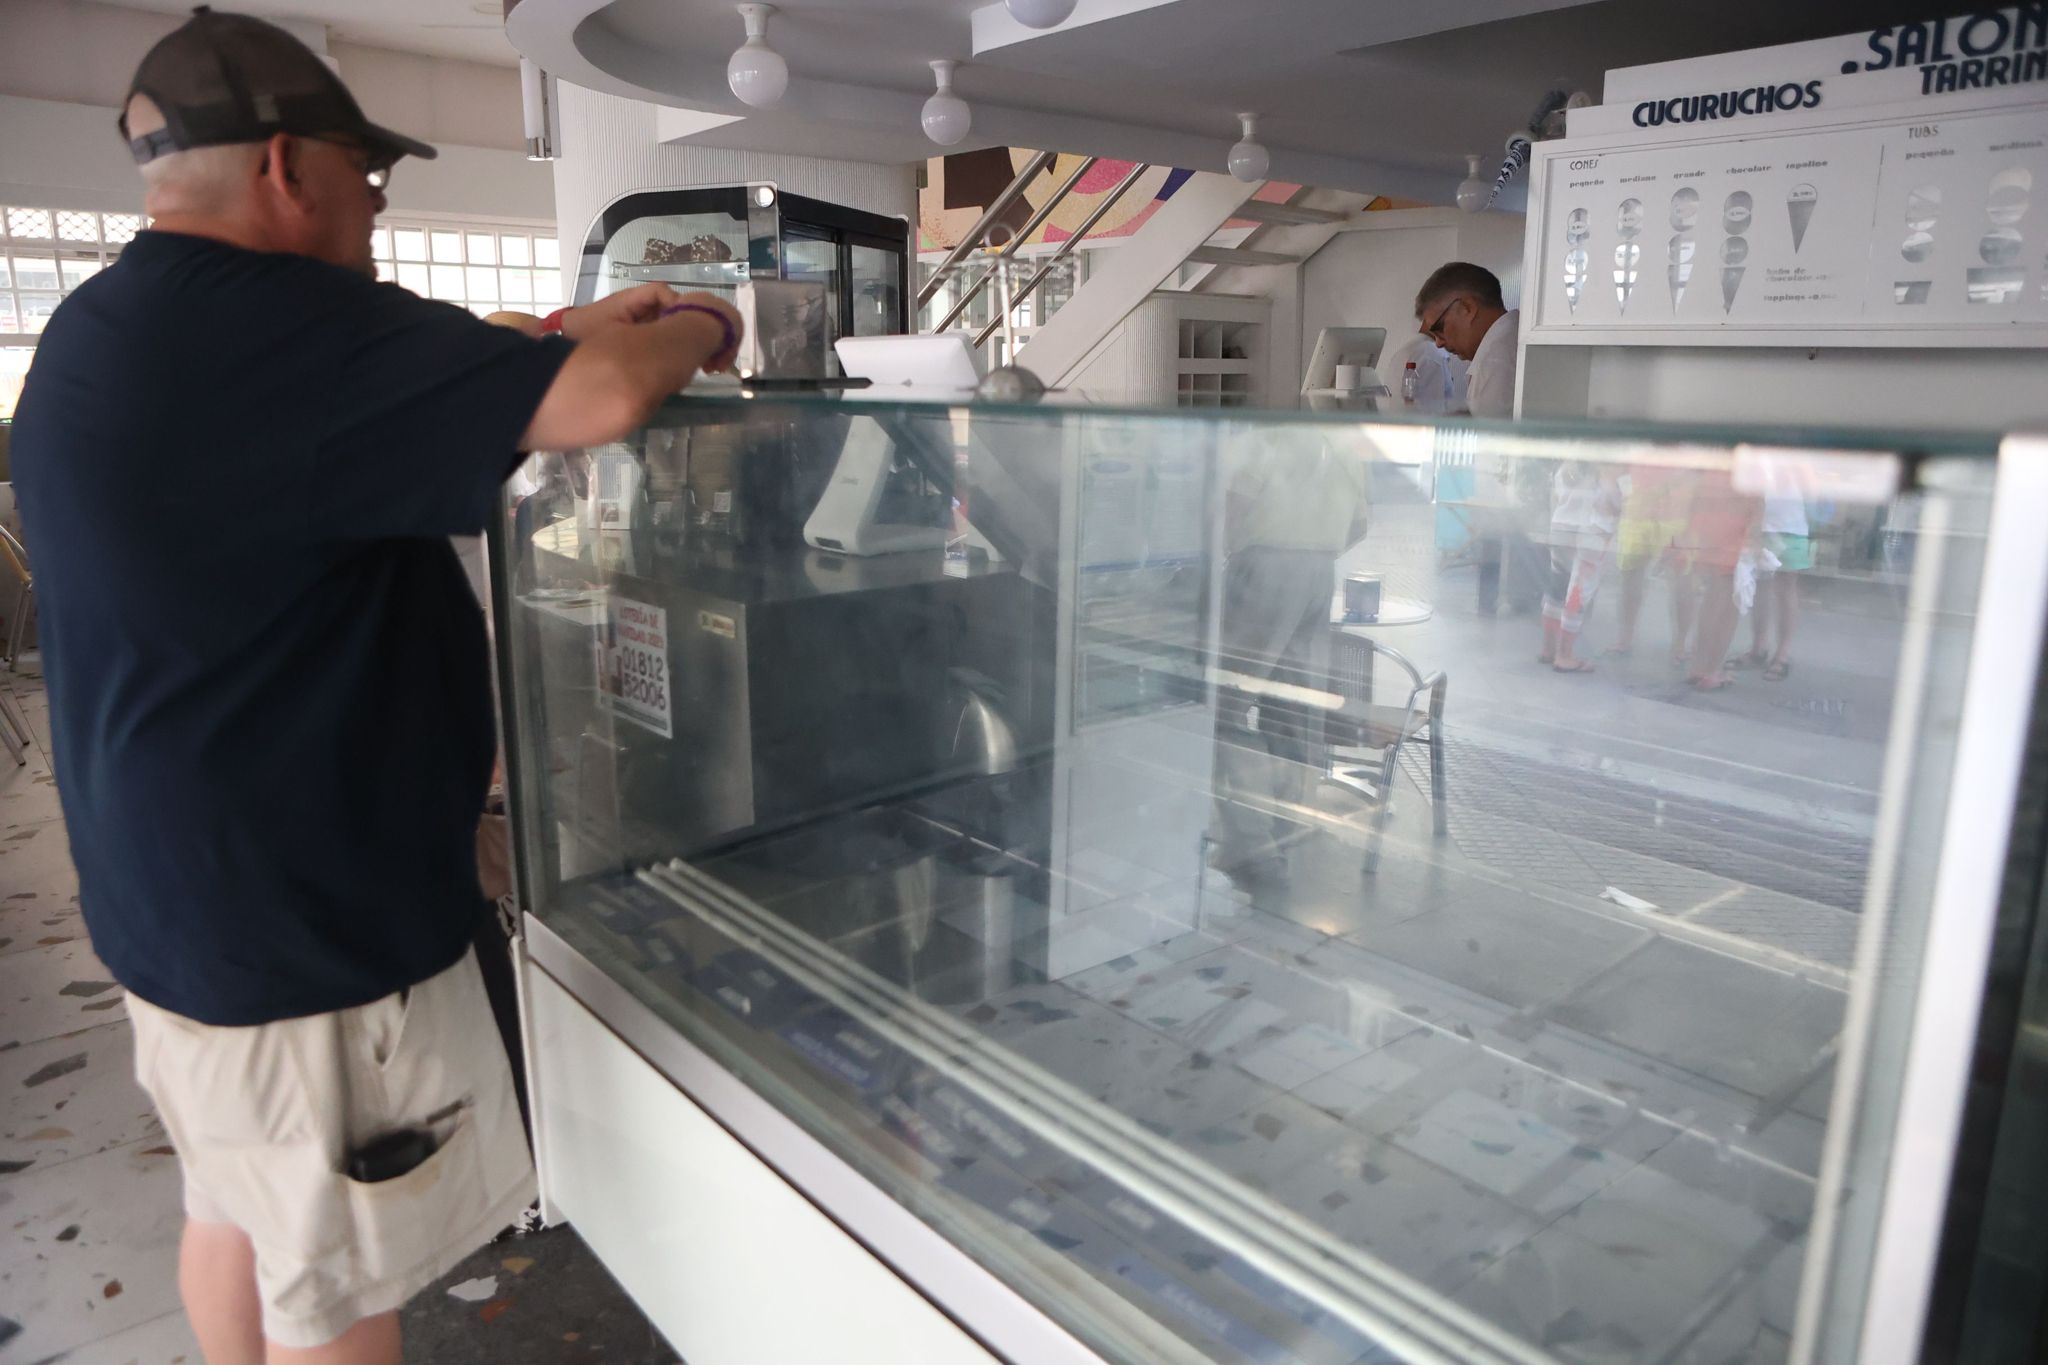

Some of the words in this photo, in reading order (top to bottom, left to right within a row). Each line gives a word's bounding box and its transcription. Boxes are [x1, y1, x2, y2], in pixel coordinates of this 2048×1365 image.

[1632, 80, 1822, 127] CUCURUCHOS
[1908, 125, 1939, 138] TUBS
[1569, 159, 1599, 170] CONES
[1726, 165, 1772, 174] chocolate
[1673, 170, 1706, 179] grande
[622, 645, 664, 682] 01812
[623, 673, 666, 711] 52006
